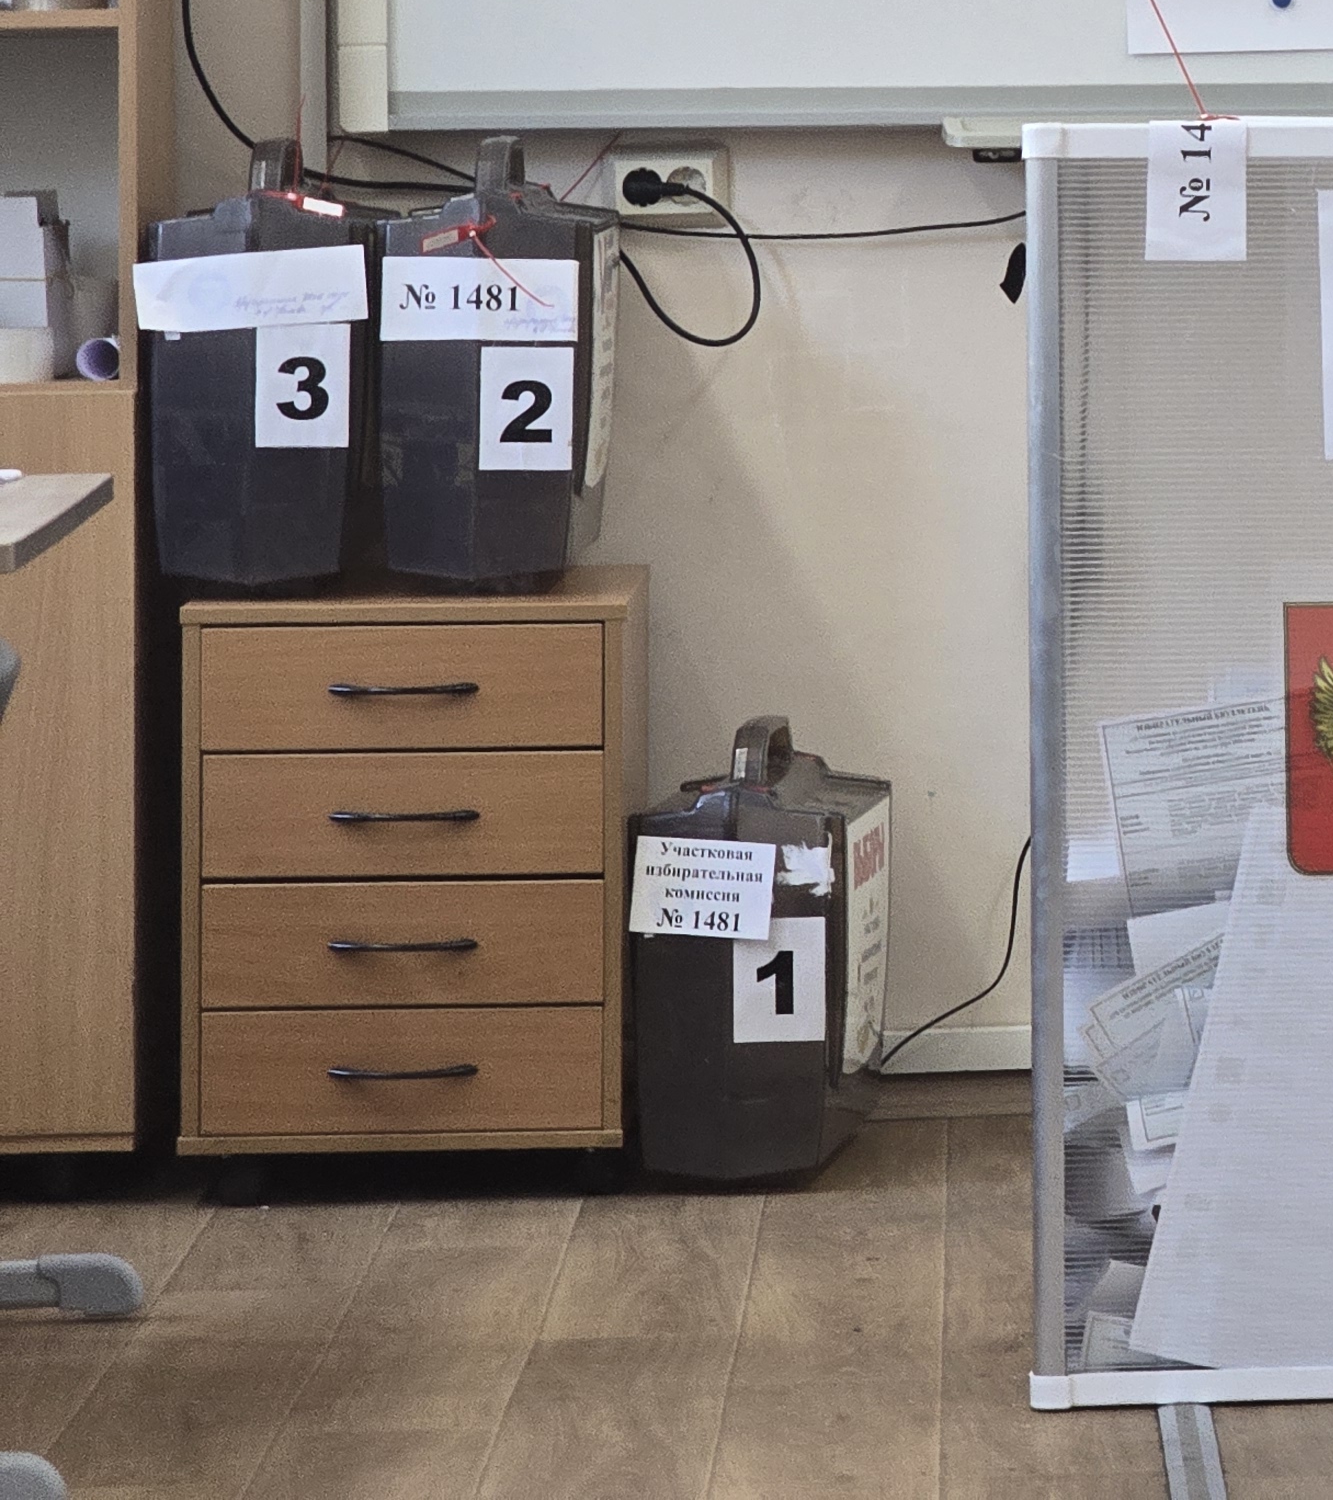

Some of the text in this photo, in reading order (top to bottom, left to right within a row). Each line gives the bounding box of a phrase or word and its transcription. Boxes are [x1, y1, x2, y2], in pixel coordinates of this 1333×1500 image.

[1179, 177, 1211, 222] №
[398, 283, 520, 312] № 1481
[276, 356, 329, 421] 3
[500, 379, 553, 443] 2
[660, 841, 753, 862] Участковая
[645, 863, 763, 883] избирательная
[664, 887, 740, 903] комиссия
[656, 907, 742, 933] № 1481
[756, 950, 794, 1015] 1
